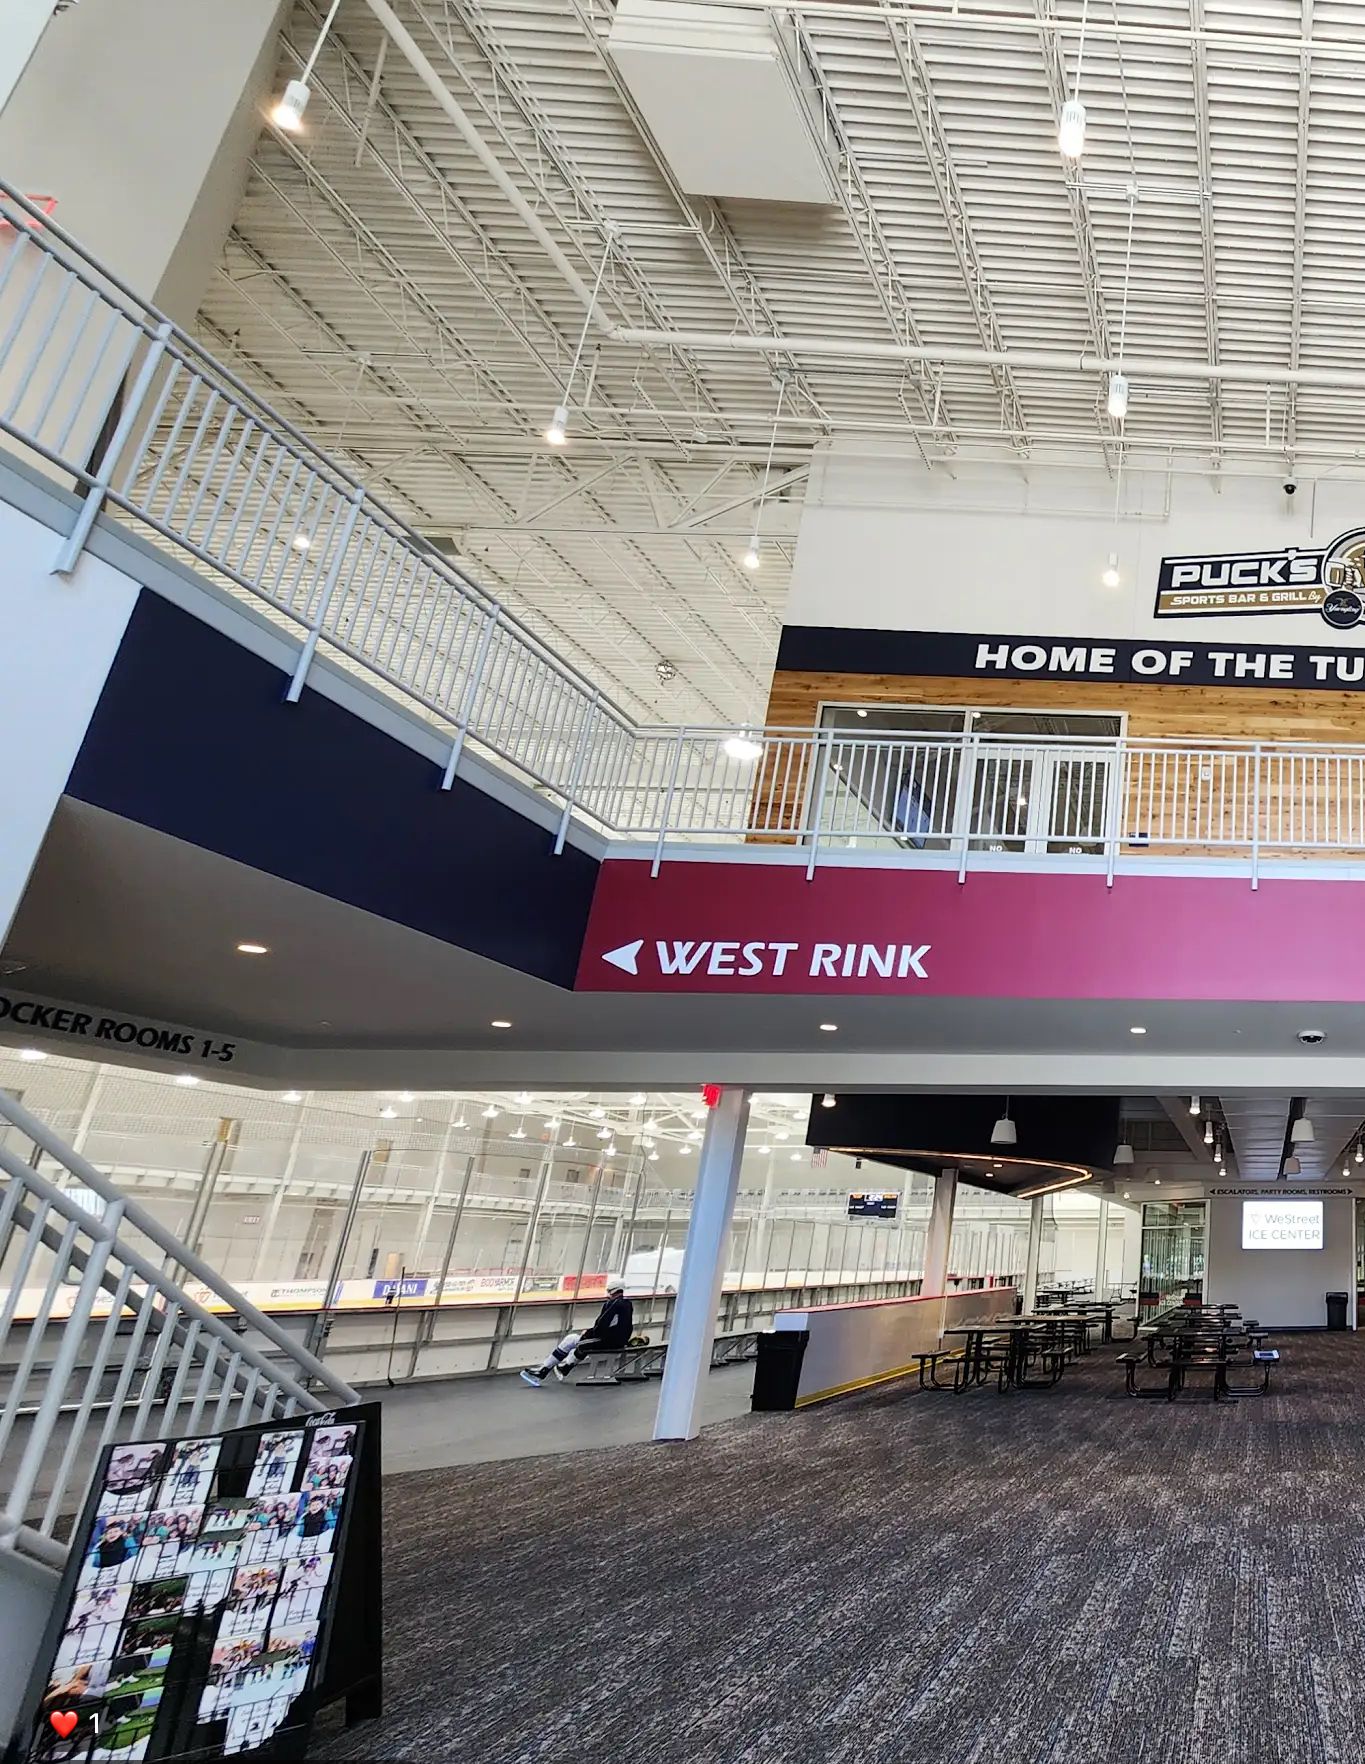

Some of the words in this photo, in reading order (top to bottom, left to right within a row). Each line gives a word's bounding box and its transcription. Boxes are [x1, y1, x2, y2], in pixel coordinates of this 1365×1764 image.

[1171, 550, 1317, 588] PUCK'S
[1170, 593, 1224, 606] SPORTS
[1228, 592, 1257, 604] BAR
[1260, 592, 1268, 602] &
[1271, 591, 1306, 602] GRILL
[974, 643, 1117, 674] HOME
[1131, 648, 1194, 676] OF
[1207, 651, 1295, 680] THE
[656, 940, 799, 976] WEST
[809, 943, 932, 979] RINK
[95, 1018, 195, 1054] ROOMS
[201, 1040, 236, 1062] 1-5
[1249, 1229, 1267, 1240] ICE
[1271, 1229, 1320, 1240] CENTER
[1265, 1213, 1320, 1225] WeStreet
